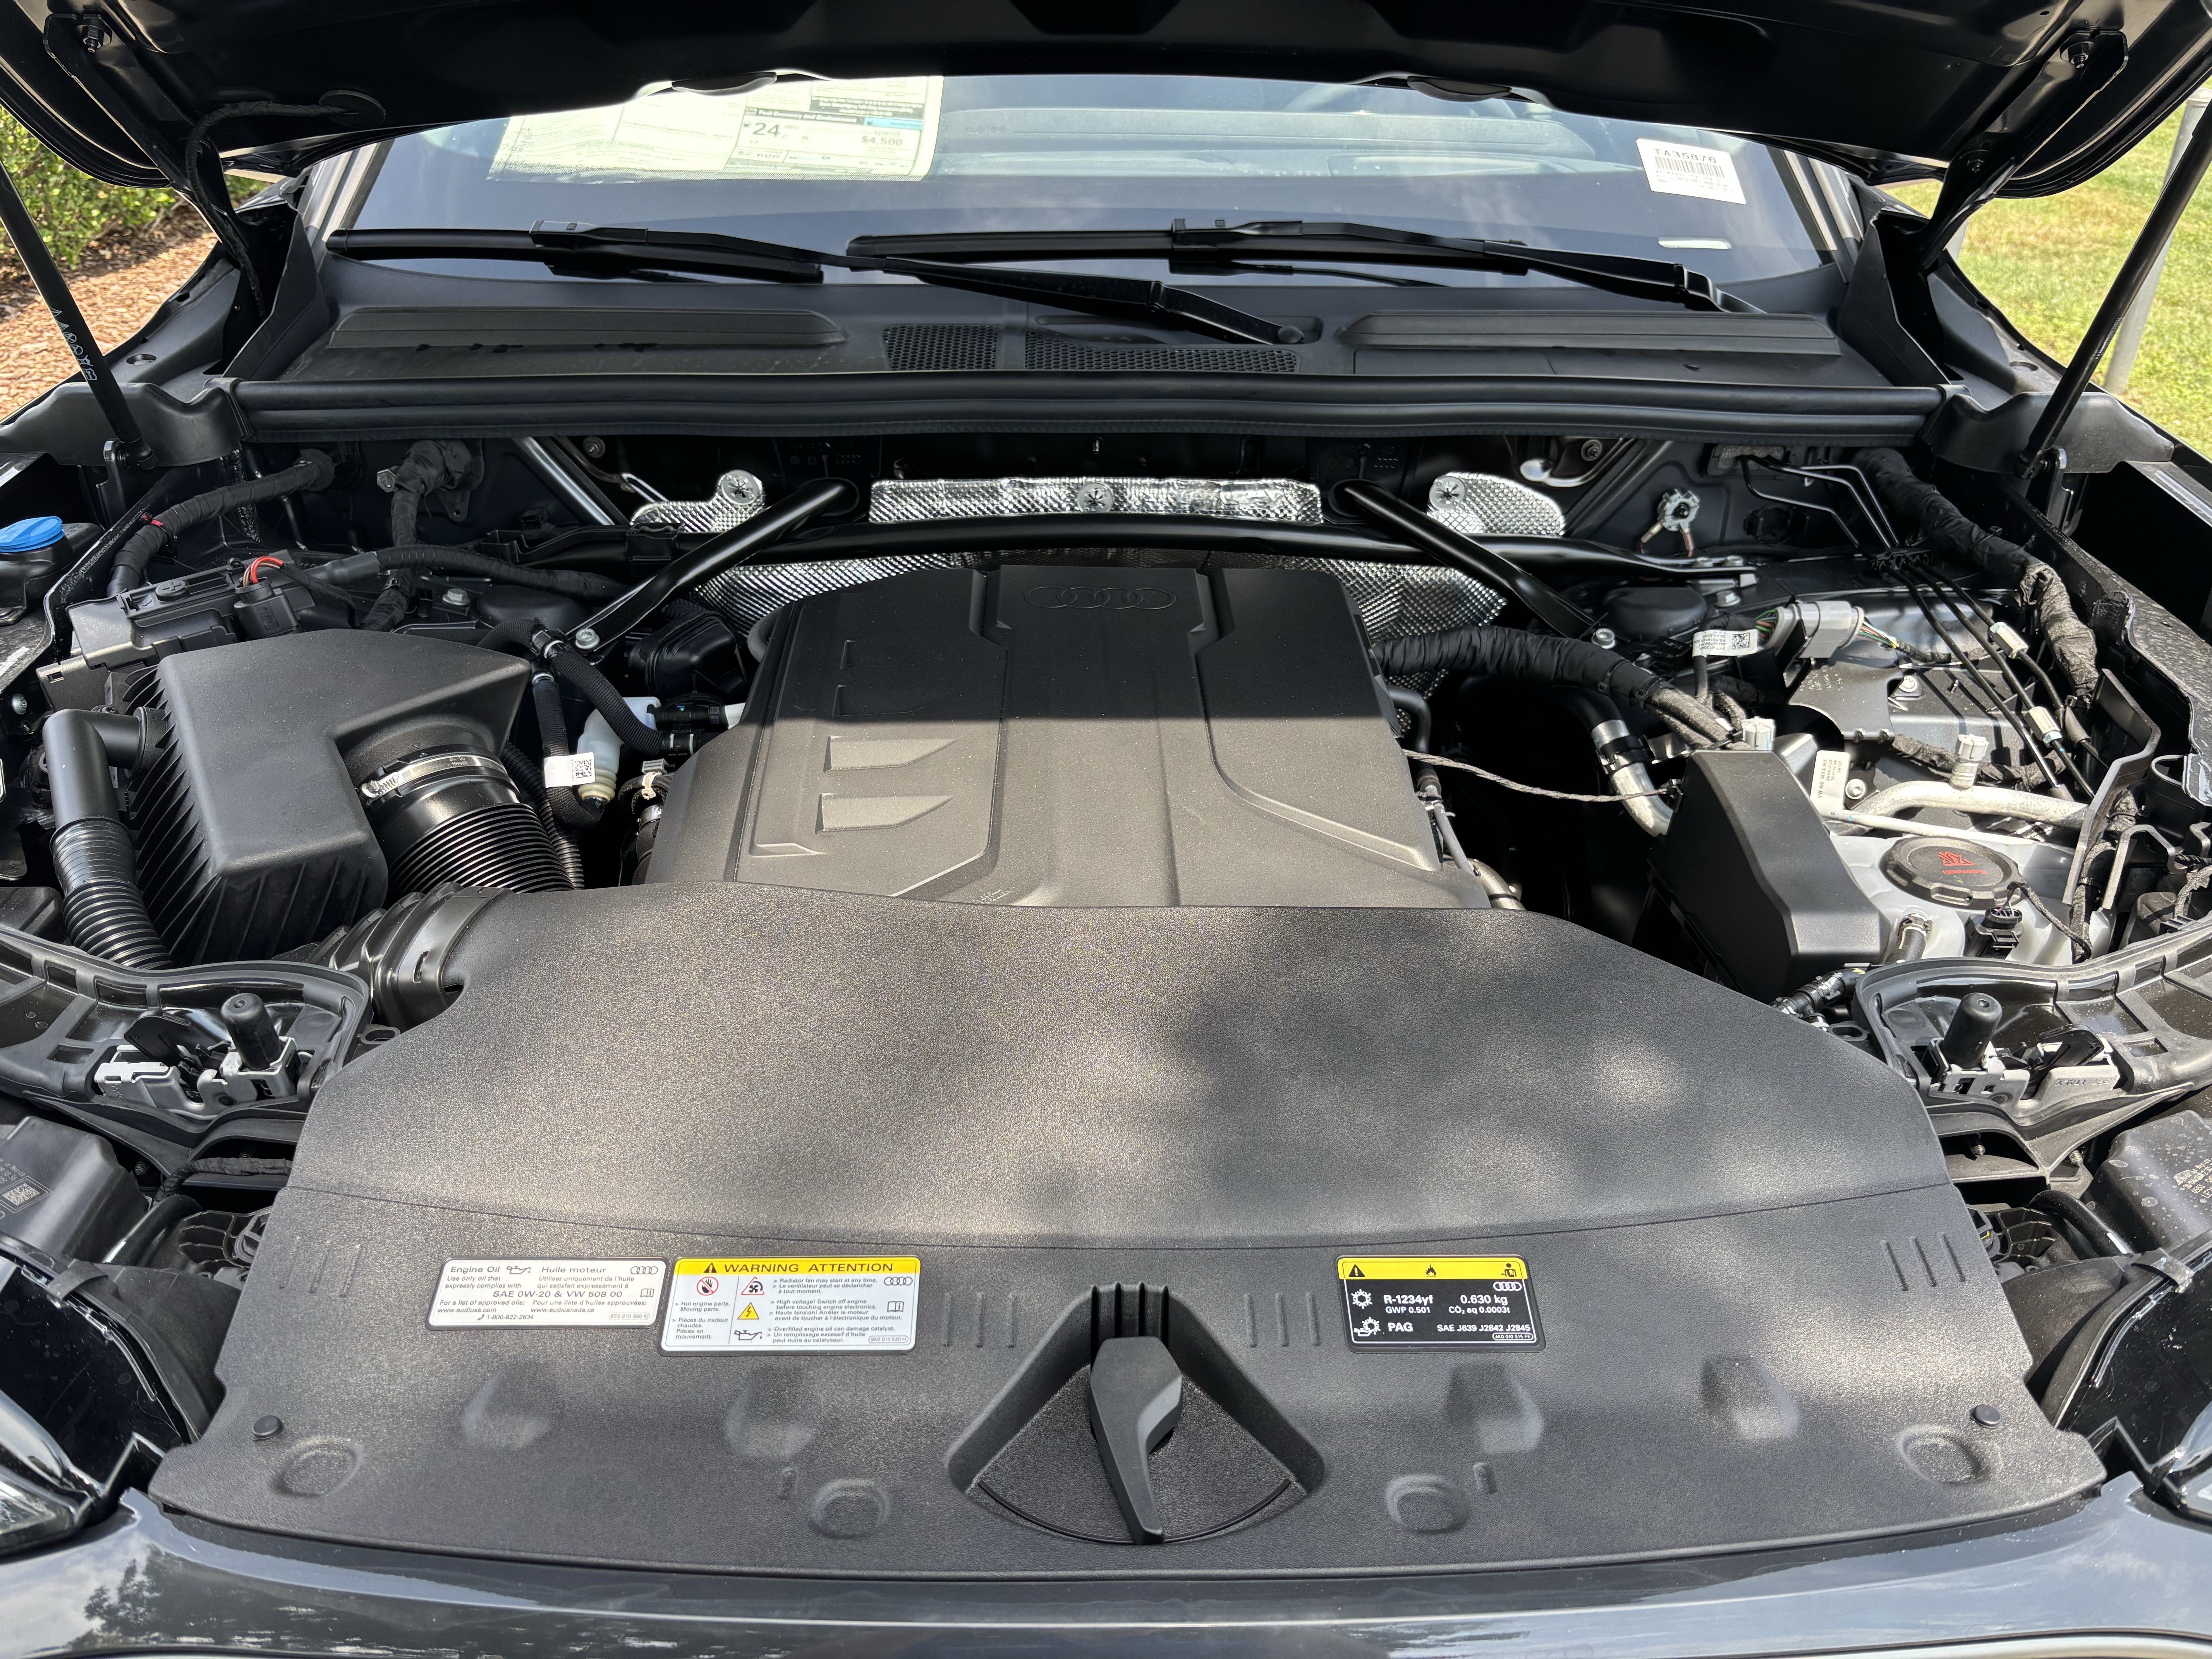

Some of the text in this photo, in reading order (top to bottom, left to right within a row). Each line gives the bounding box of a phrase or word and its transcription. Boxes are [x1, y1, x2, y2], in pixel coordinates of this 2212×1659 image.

[752, 122, 780, 136] 24
[861, 136, 903, 146] $4,500
[724, 1263, 893, 1272] WARNING ATTENTION
[1384, 1295, 1433, 1306] R-1234yf
[1460, 1295, 1508, 1305] 0.630 kg
[1388, 1322, 1413, 1332] PAG
